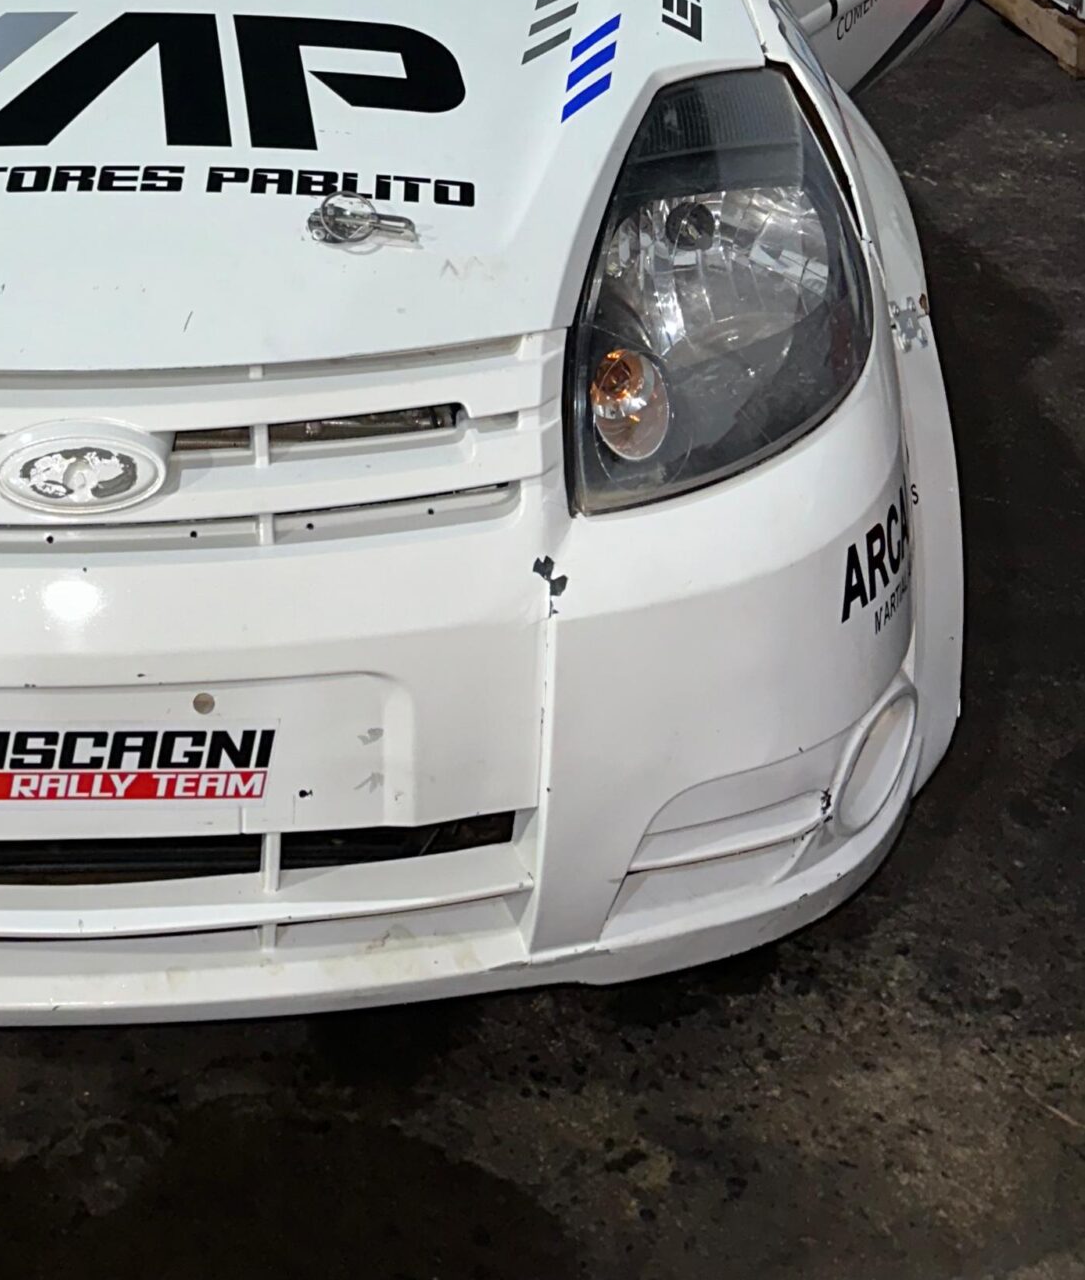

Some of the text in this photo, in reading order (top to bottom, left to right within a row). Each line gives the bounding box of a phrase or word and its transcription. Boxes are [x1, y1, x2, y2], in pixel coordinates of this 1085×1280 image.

[204, 166, 477, 208] PABLITO
[8, 772, 263, 799] RALLY TEAM
